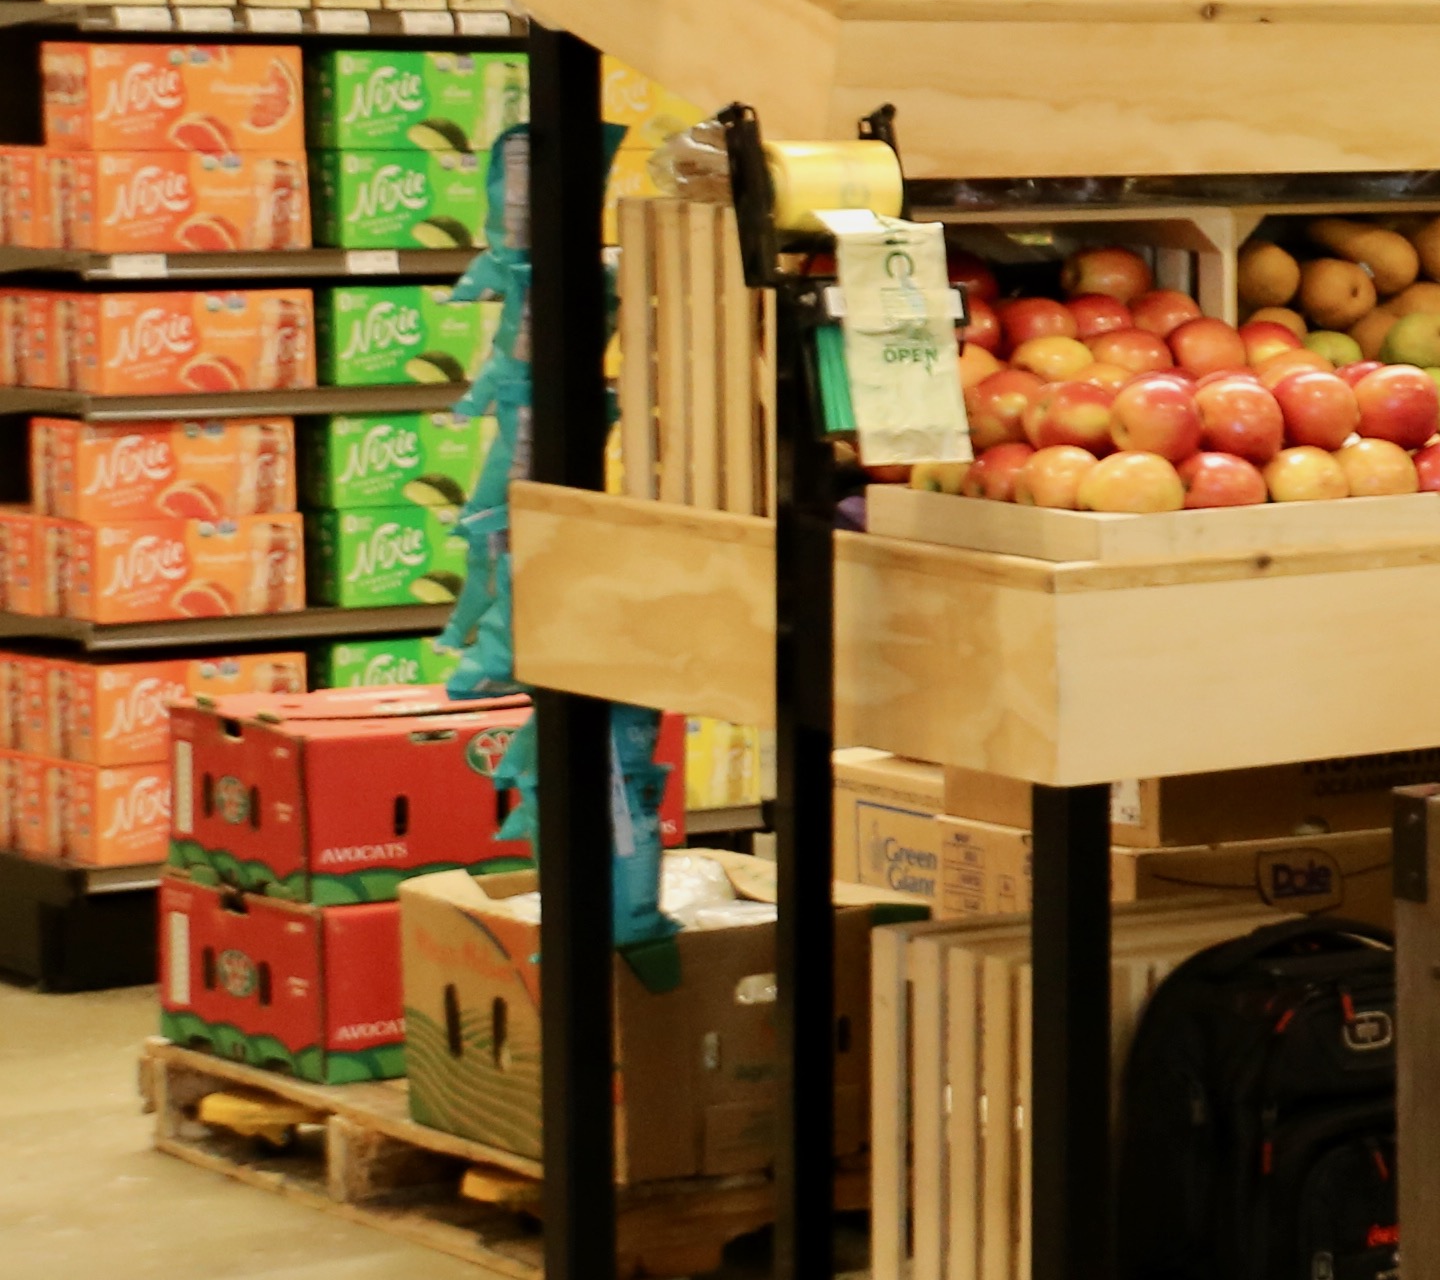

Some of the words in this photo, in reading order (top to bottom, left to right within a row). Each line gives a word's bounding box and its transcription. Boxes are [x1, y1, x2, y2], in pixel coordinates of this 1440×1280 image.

[94, 61, 183, 120] Nixie
[343, 65, 424, 123] Nixie
[104, 165, 191, 226] Nixie
[346, 164, 428, 222] Nixie
[105, 308, 195, 368] Nixie
[340, 301, 423, 360] Nixie
[884, 346, 938, 364] OPEN
[82, 434, 173, 496] Nixie
[339, 424, 420, 484] Nixie
[103, 535, 187, 597] Nixie
[346, 522, 428, 584] Nixie
[320, 842, 408, 865] AVOCATS
[885, 836, 938, 871] Green
[887, 861, 936, 897] Giant
[1271, 860, 1333, 898] Dole
